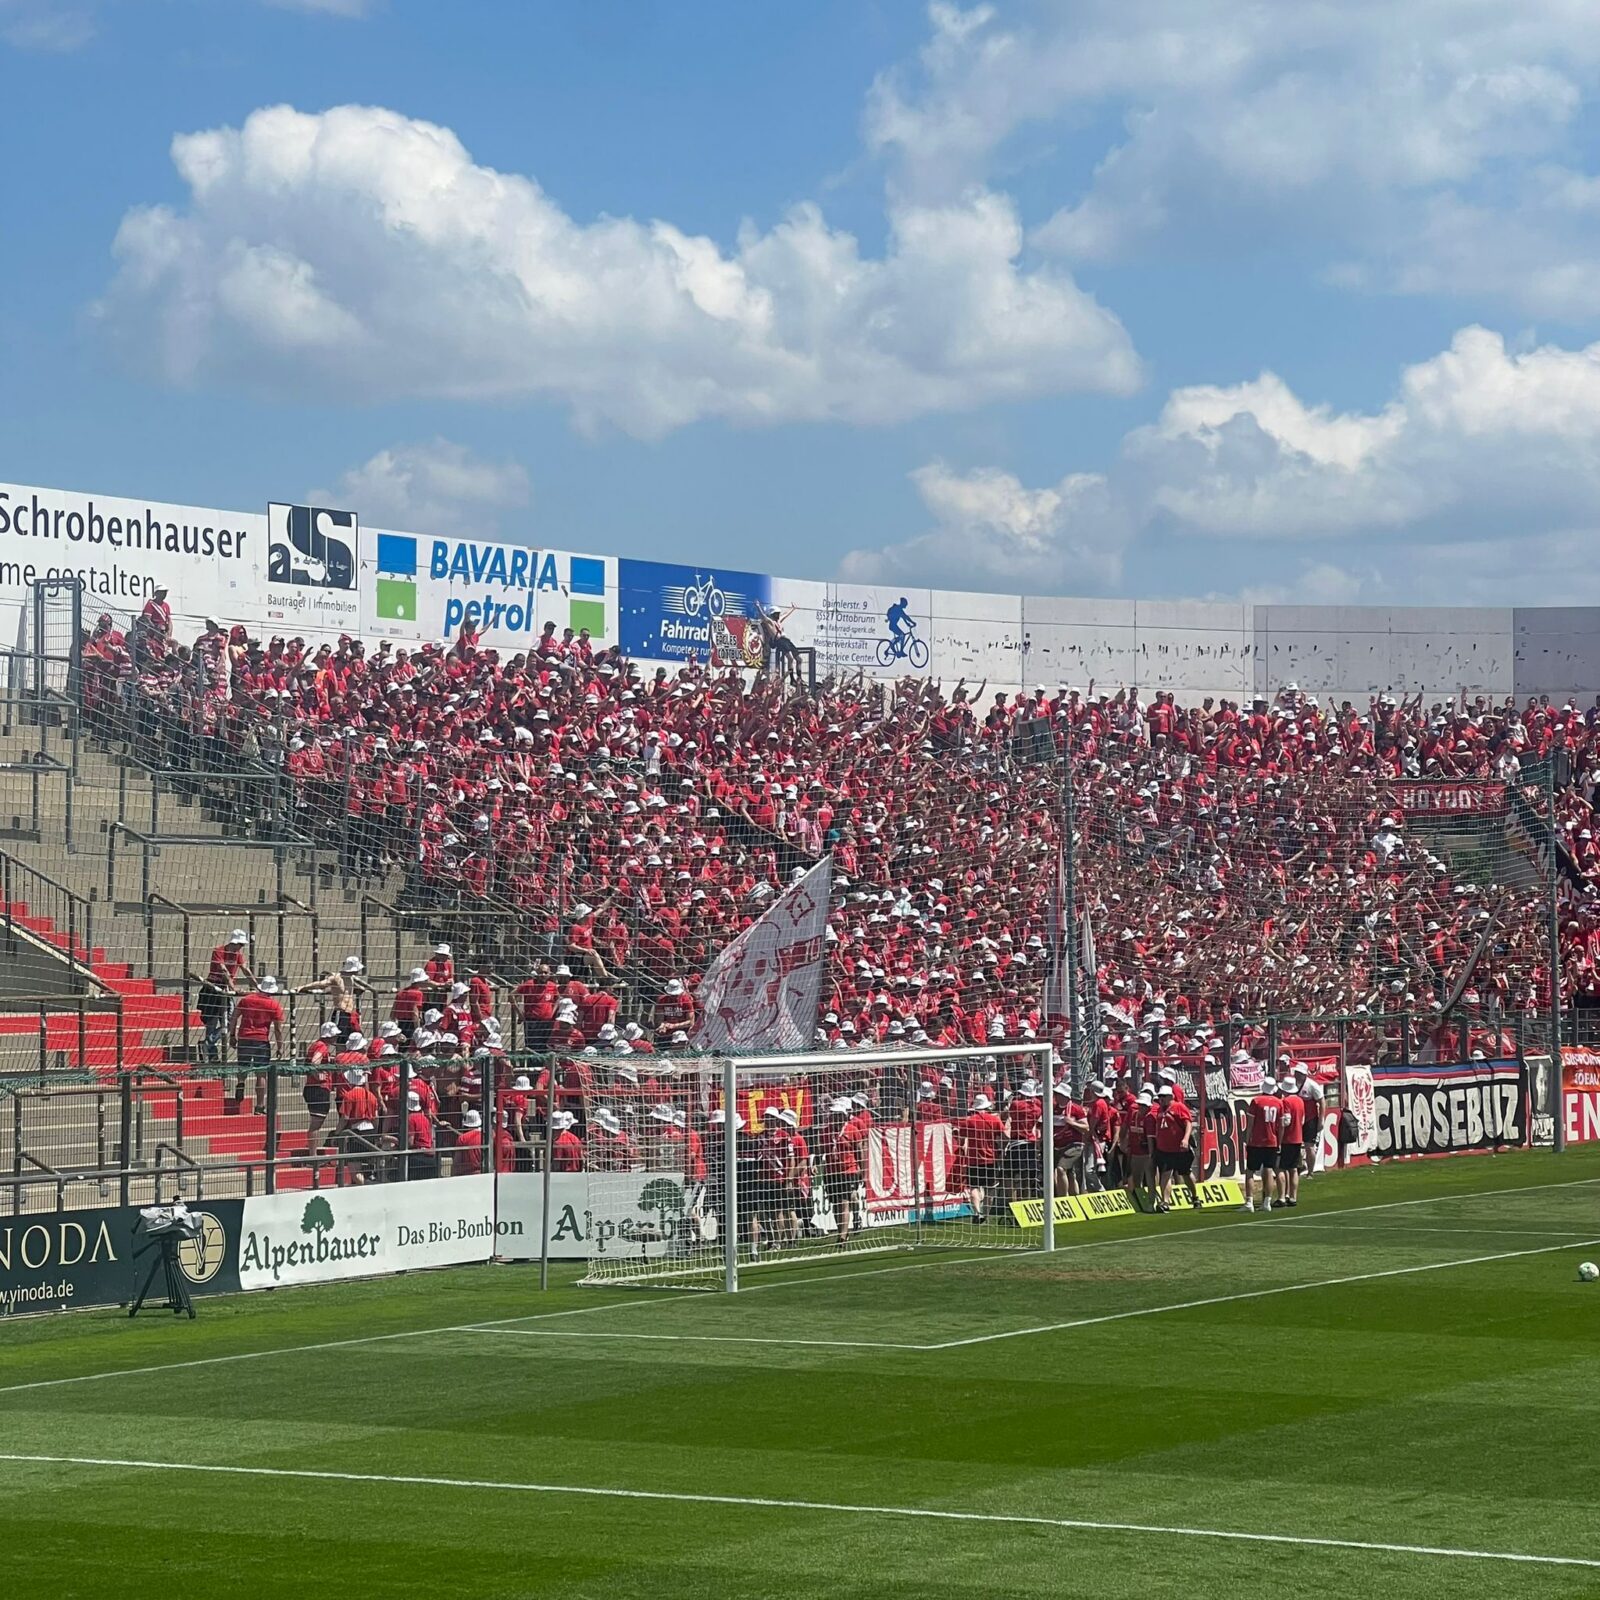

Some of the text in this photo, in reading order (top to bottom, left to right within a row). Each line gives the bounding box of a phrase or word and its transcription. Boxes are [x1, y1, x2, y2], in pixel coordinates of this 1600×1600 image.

[0, 492, 247, 559] Schrobenhauser
[430, 540, 558, 591] BAVARIA
[267, 593, 357, 614] Bauträger Immobilien
[444, 590, 534, 637] petrol
[862, 601, 868, 610] 9
[660, 619, 710, 642] Fahrrad
[835, 613, 876, 624] Ottobrunn
[850, 652, 875, 662] Center
[1263, 1105, 1278, 1123] 10
[1375, 1079, 1519, 1151] CHOŚEBUZ
[1023, 1200, 1076, 1223] AUFLASI
[1087, 1191, 1133, 1214] AUFBLASI
[240, 1215, 524, 1281] Alpenbauer Das Bio-Bonbon
